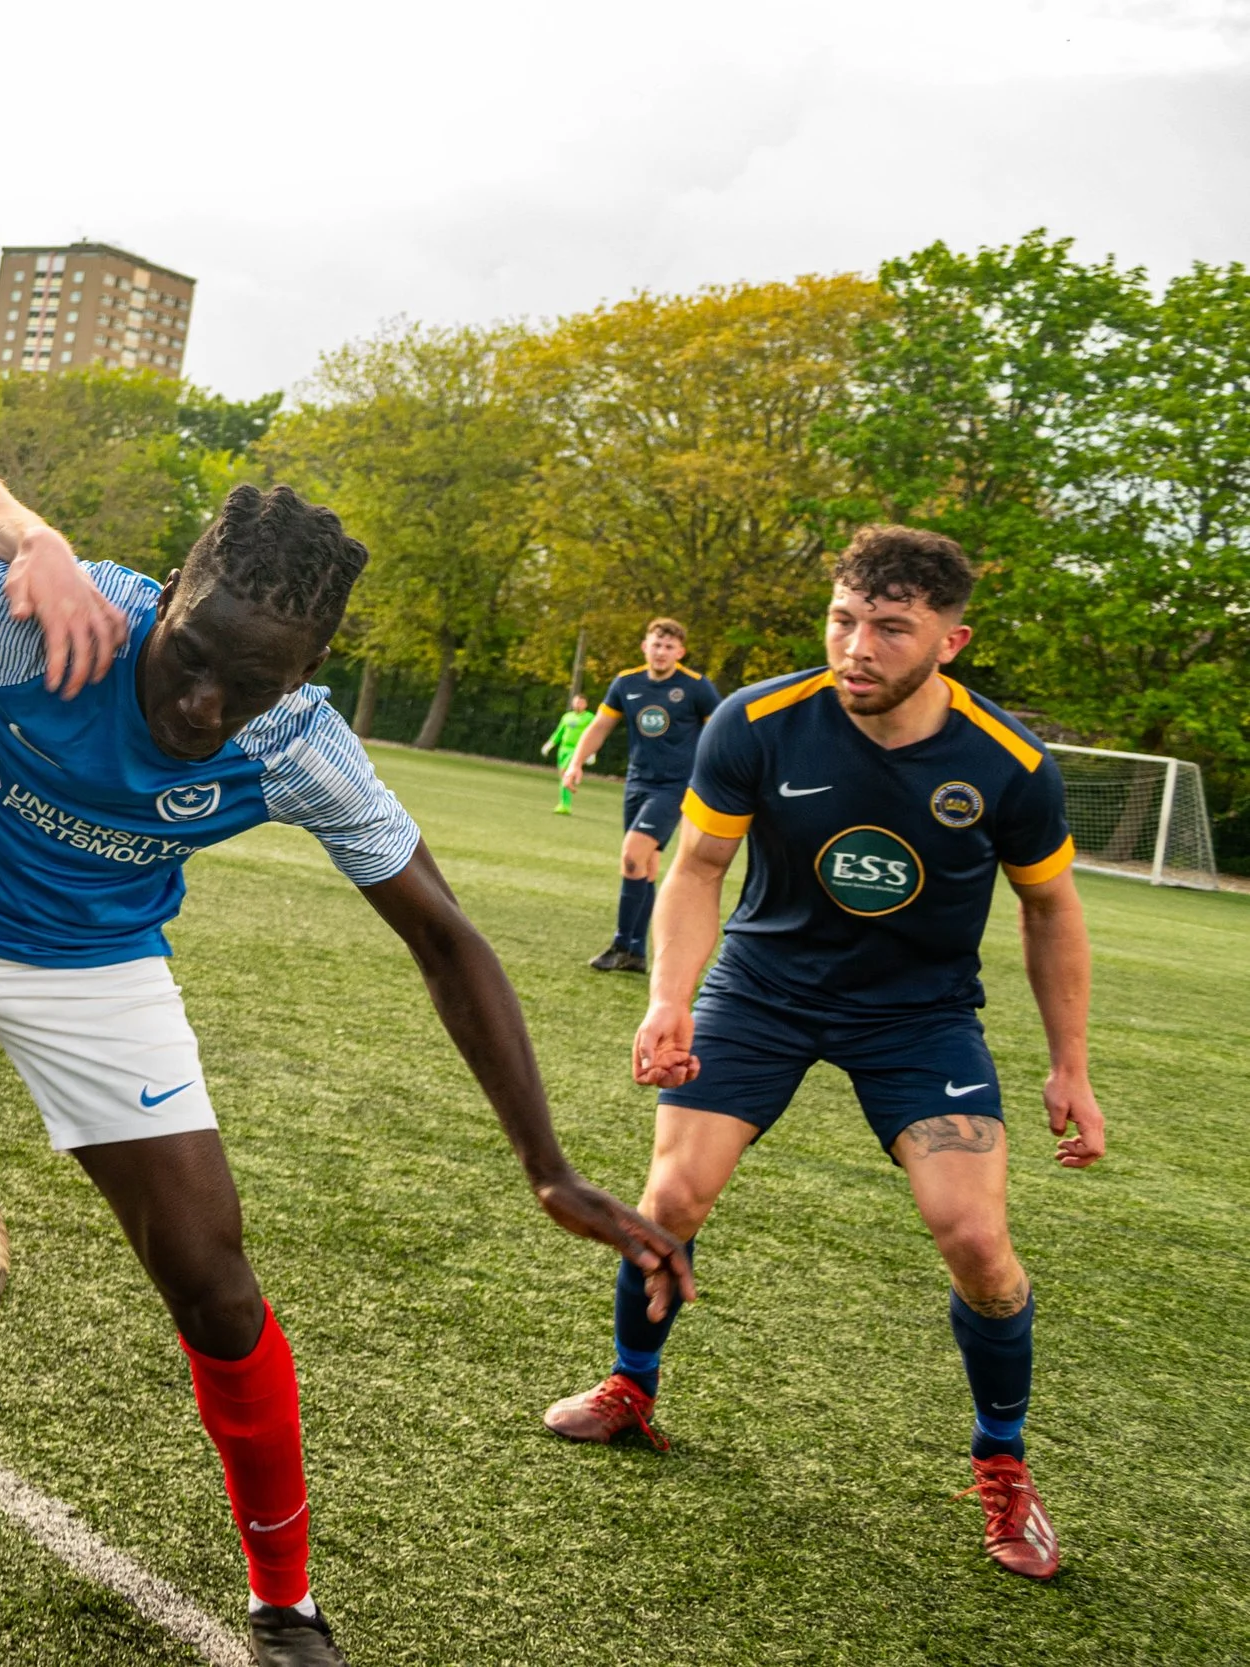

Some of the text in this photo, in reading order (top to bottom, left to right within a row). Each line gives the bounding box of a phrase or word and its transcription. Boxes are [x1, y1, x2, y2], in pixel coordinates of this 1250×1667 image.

[2, 796, 175, 866] PORTSMOUT
[9, 783, 181, 855] UNIVERSITY
[833, 852, 908, 886] ESS
